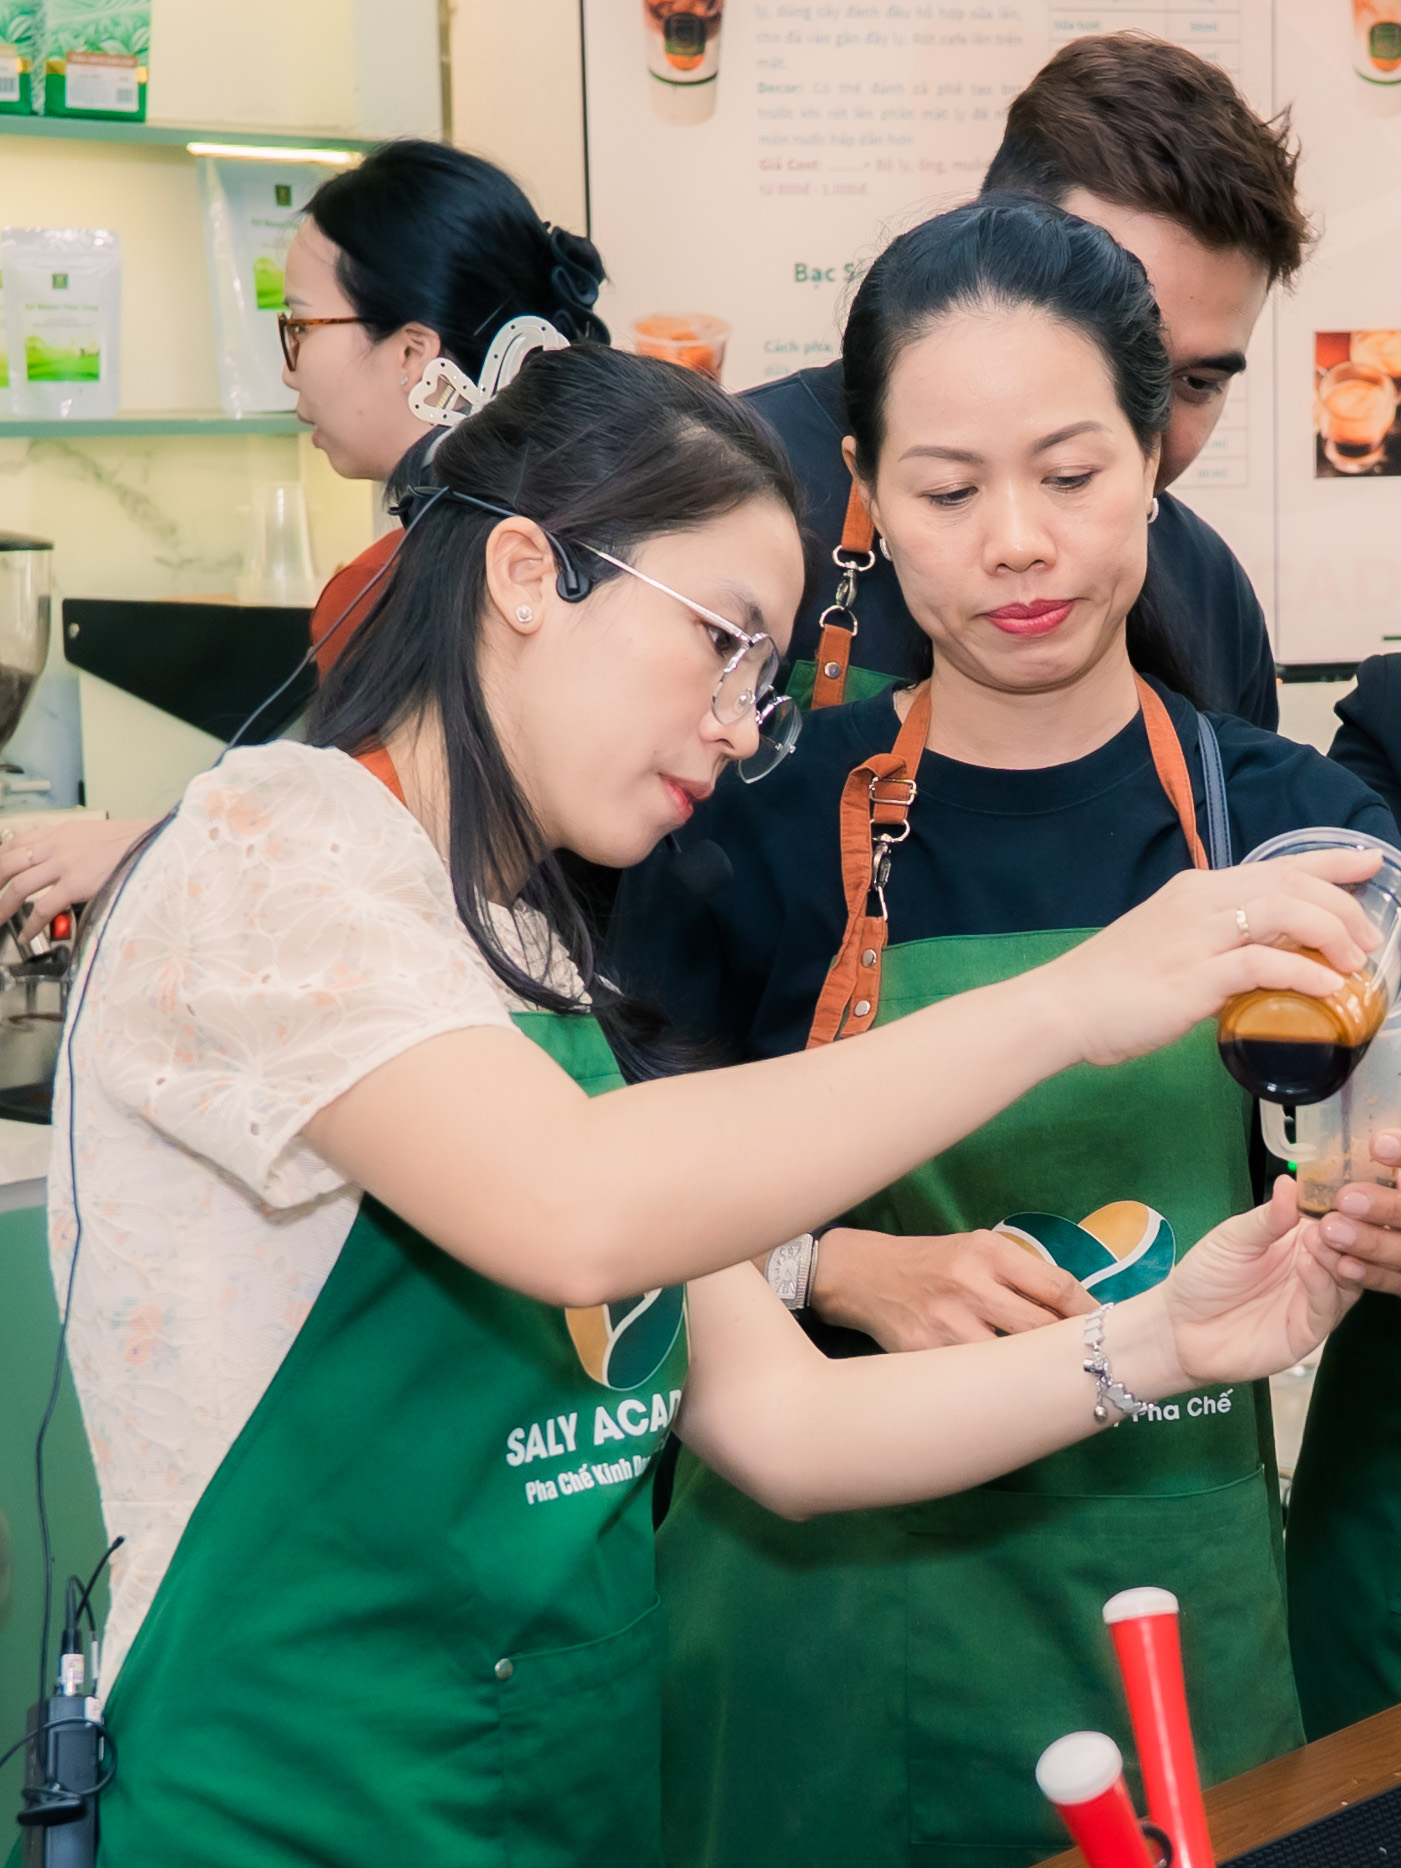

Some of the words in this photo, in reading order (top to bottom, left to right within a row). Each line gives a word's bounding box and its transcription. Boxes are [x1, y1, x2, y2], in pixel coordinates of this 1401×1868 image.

[794, 263, 835, 289] Bạc
[1187, 1389, 1234, 1416] Chế
[506, 1412, 578, 1467] SALY
[593, 1389, 682, 1446] ACAD
[525, 1478, 559, 1505] Pha
[557, 1463, 595, 1495] Chế
[591, 1458, 634, 1486] Kinh
